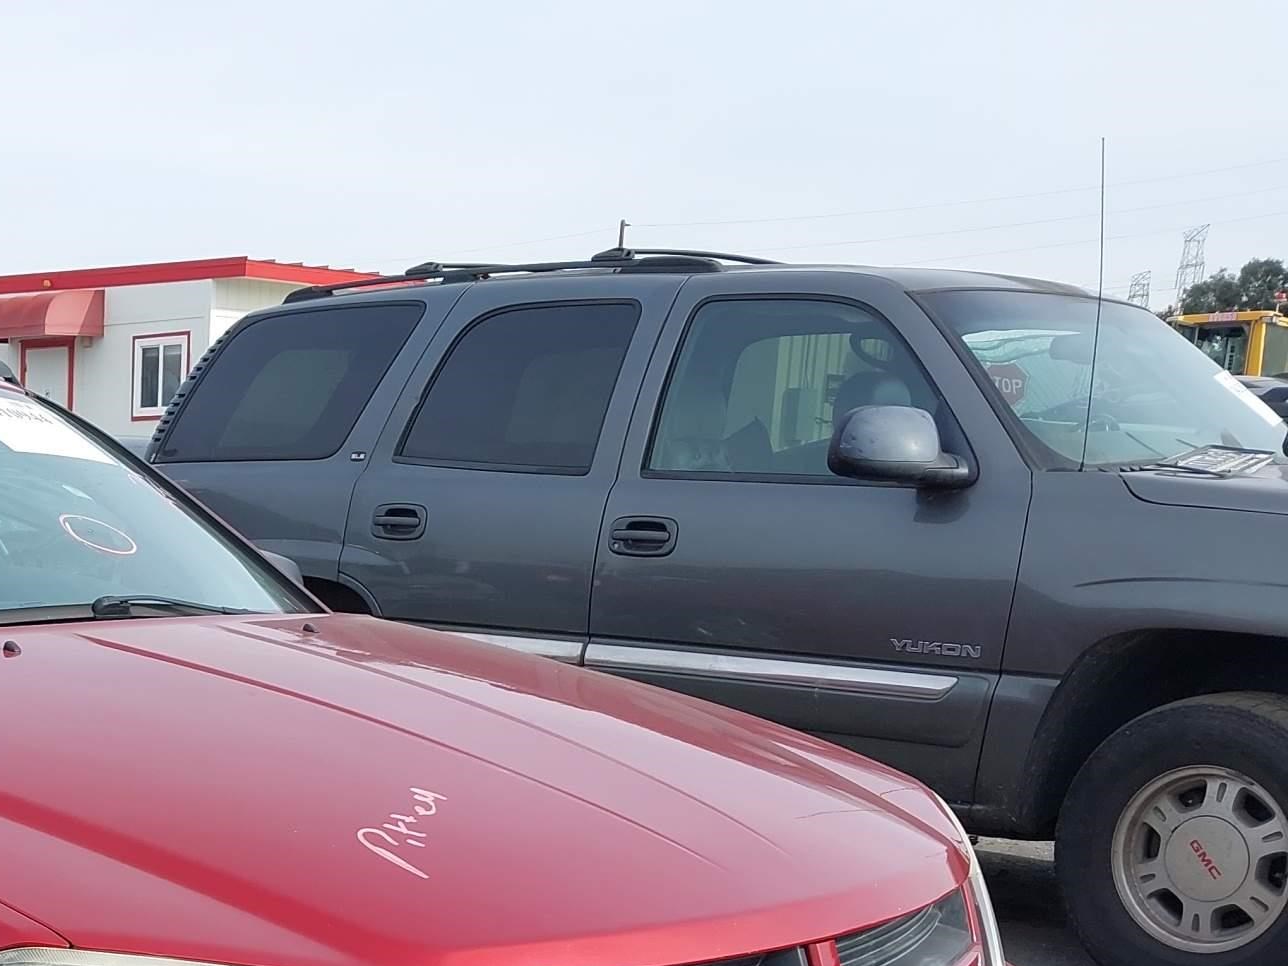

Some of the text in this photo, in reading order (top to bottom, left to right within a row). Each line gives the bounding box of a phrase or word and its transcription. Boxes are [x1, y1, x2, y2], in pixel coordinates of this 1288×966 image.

[992, 375, 1023, 395] TOP
[890, 638, 982, 658] YUKON
[1190, 839, 1222, 880] GMC
